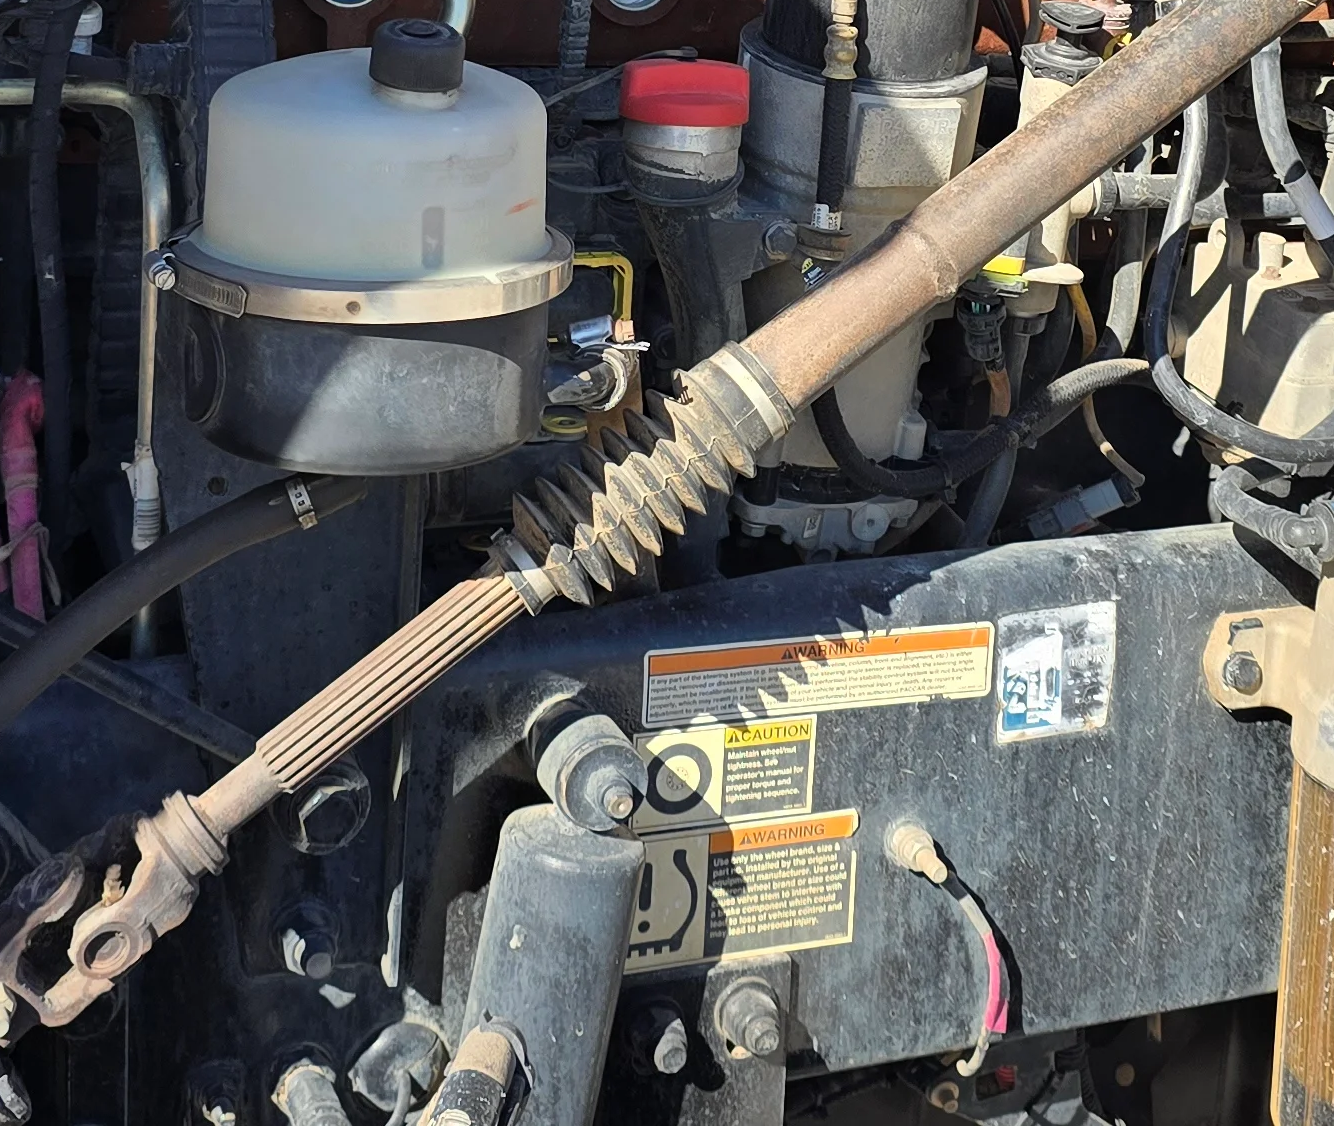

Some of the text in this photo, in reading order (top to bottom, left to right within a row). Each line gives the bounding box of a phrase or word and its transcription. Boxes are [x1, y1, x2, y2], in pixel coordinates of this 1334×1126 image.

[793, 642, 865, 658] WARNING
[899, 686, 925, 694] PACCAR
[741, 723, 809, 742] CAUTION
[727, 748, 759, 760] Maintain
[765, 765, 792, 777] manual
[793, 764, 804, 774] for
[725, 776, 791, 794] proper torque and
[725, 790, 761, 804] tightening
[752, 823, 825, 844] WARNING
[713, 856, 729, 867] Use
[730, 854, 747, 866] only
[749, 852, 763, 862] the
[765, 848, 788, 860] wheel
[817, 843, 833, 853] size
[712, 867, 729, 878] part
[780, 859, 791, 870] by
[793, 857, 805, 867] the
[807, 853, 837, 866] original
[813, 864, 828, 875] Use
[829, 863, 838, 873] of
[747, 881, 771, 893] wheel
[773, 878, 795, 890] brand
[797, 878, 806, 887] or
[807, 875, 823, 885] size
[825, 871, 847, 883] could
[737, 894, 758, 905] valve
[759, 892, 779, 902] stem
[781, 890, 790, 899] to
[825, 882, 842, 893] with
[729, 917, 737, 926] to
[757, 912, 766, 922] of
[767, 908, 797, 921] vehicle
[798, 904, 826, 916] control
[827, 901, 842, 912] and
[741, 901, 787, 916] component
[789, 896, 812, 908] which
[814, 893, 836, 905] could
[727, 925, 746, 936] lead
[747, 924, 755, 934] to
[757, 919, 792, 934] personal
